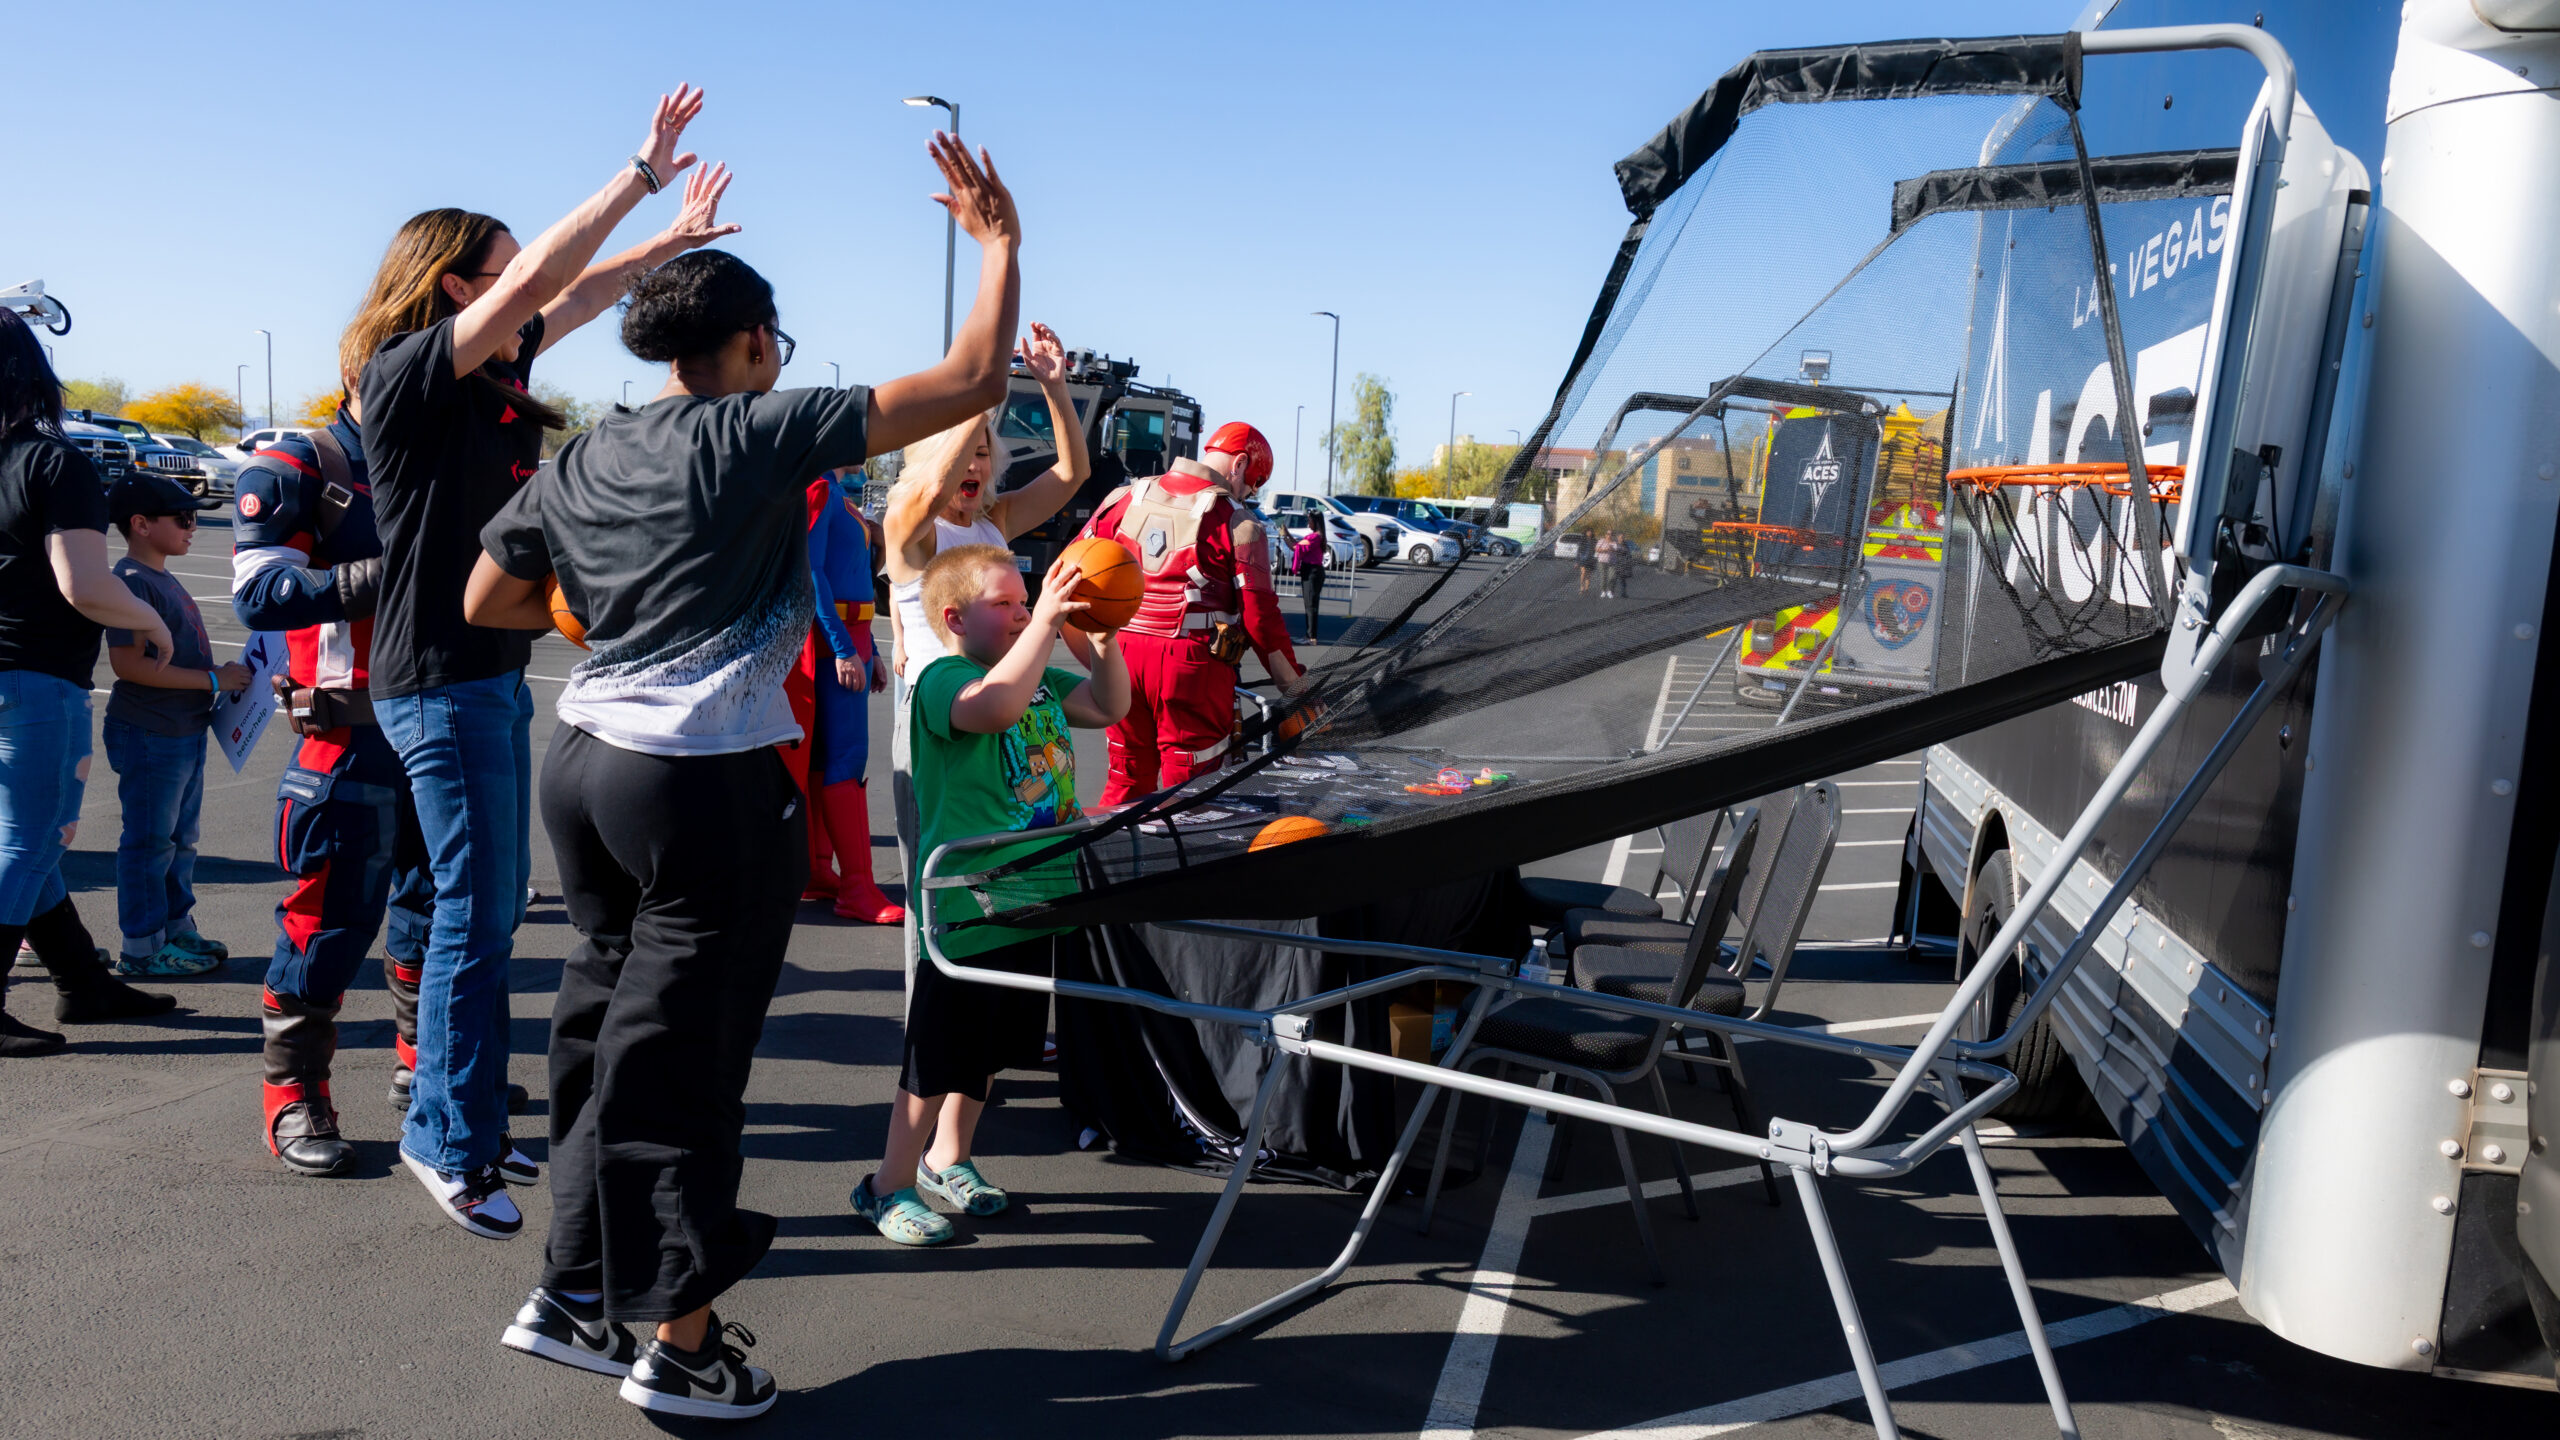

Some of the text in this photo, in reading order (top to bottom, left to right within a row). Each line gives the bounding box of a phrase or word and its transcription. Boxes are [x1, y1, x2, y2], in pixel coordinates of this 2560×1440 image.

[2129, 195, 2231, 299] VEGAS
[1803, 465, 1839, 481] ACES
[2004, 322, 2209, 608] ACE
[236, 707, 268, 758] betterhelp
[240, 701, 258, 728] TOYOTA
